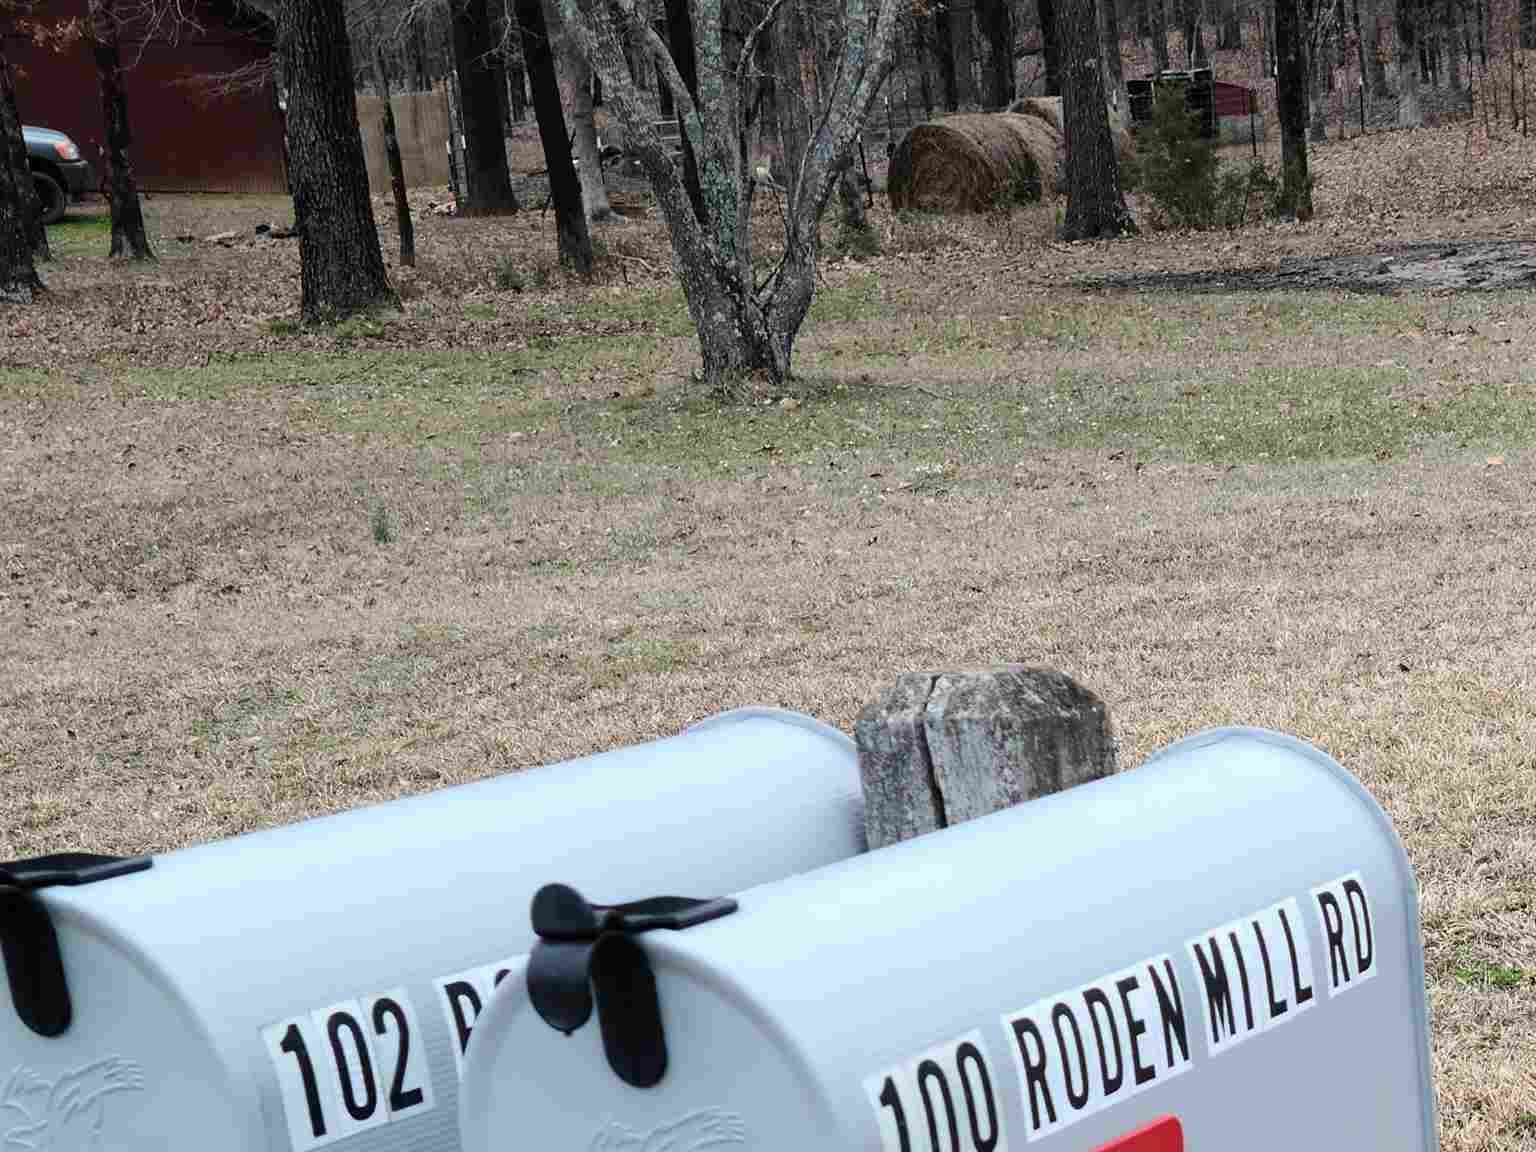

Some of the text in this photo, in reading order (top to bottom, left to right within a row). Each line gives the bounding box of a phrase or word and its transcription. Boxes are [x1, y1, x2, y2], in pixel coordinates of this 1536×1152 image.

[279, 997, 424, 1138] 102
[1011, 959, 1190, 1131] RODEN
[1193, 909, 1313, 1044] MILL
[1317, 879, 1373, 988] RD
